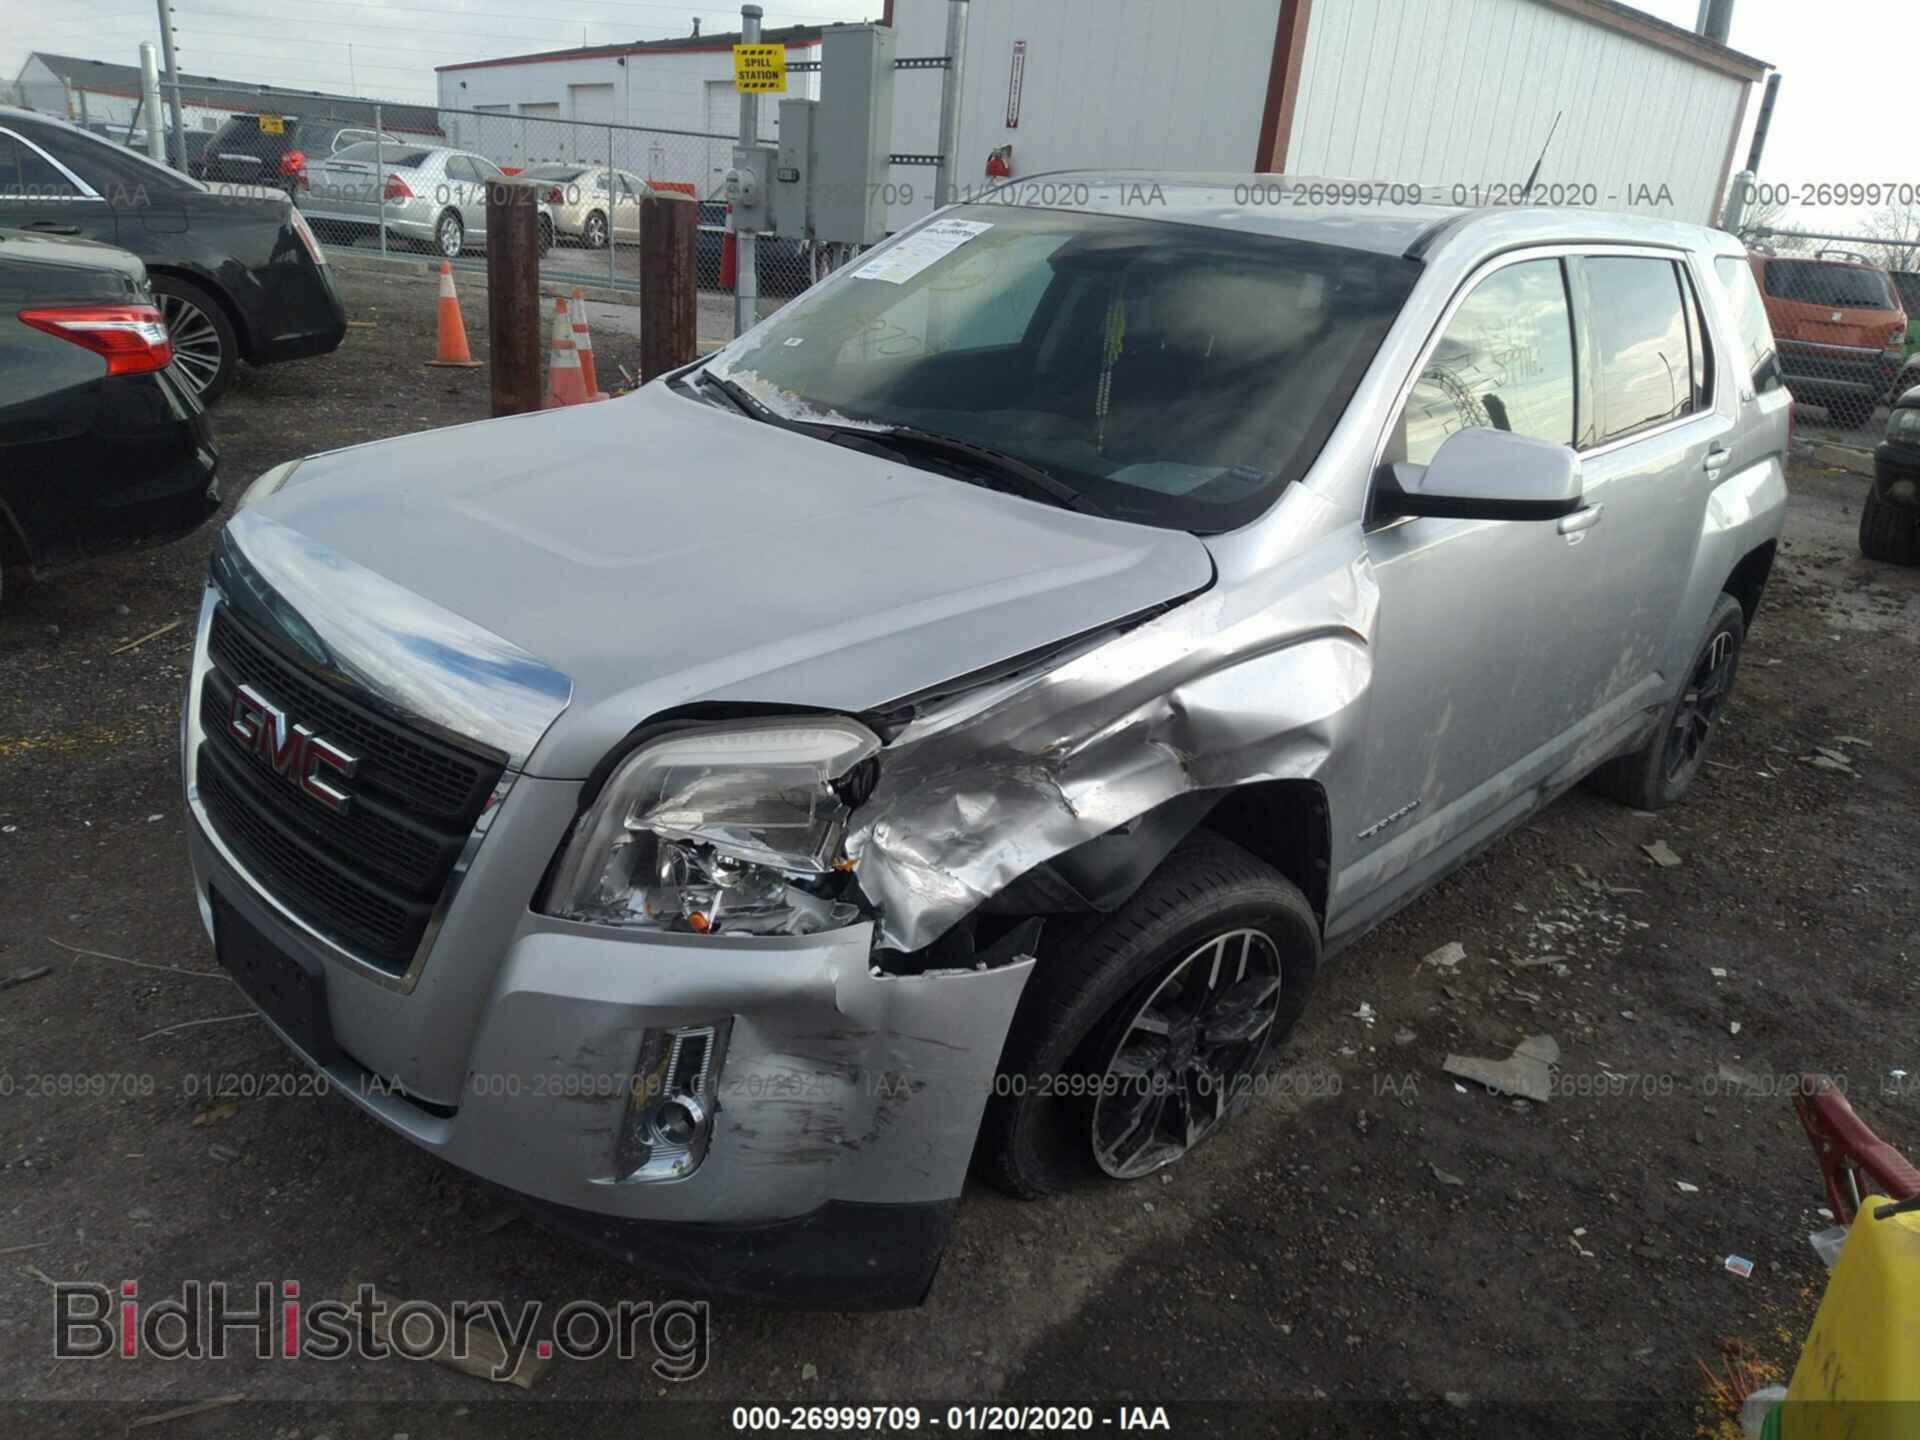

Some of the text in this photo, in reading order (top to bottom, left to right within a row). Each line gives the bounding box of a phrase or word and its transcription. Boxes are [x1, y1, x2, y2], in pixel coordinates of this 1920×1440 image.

[743, 57, 772, 68] SPILL
[738, 70, 779, 80] STATION
[228, 683, 358, 815] GMC
